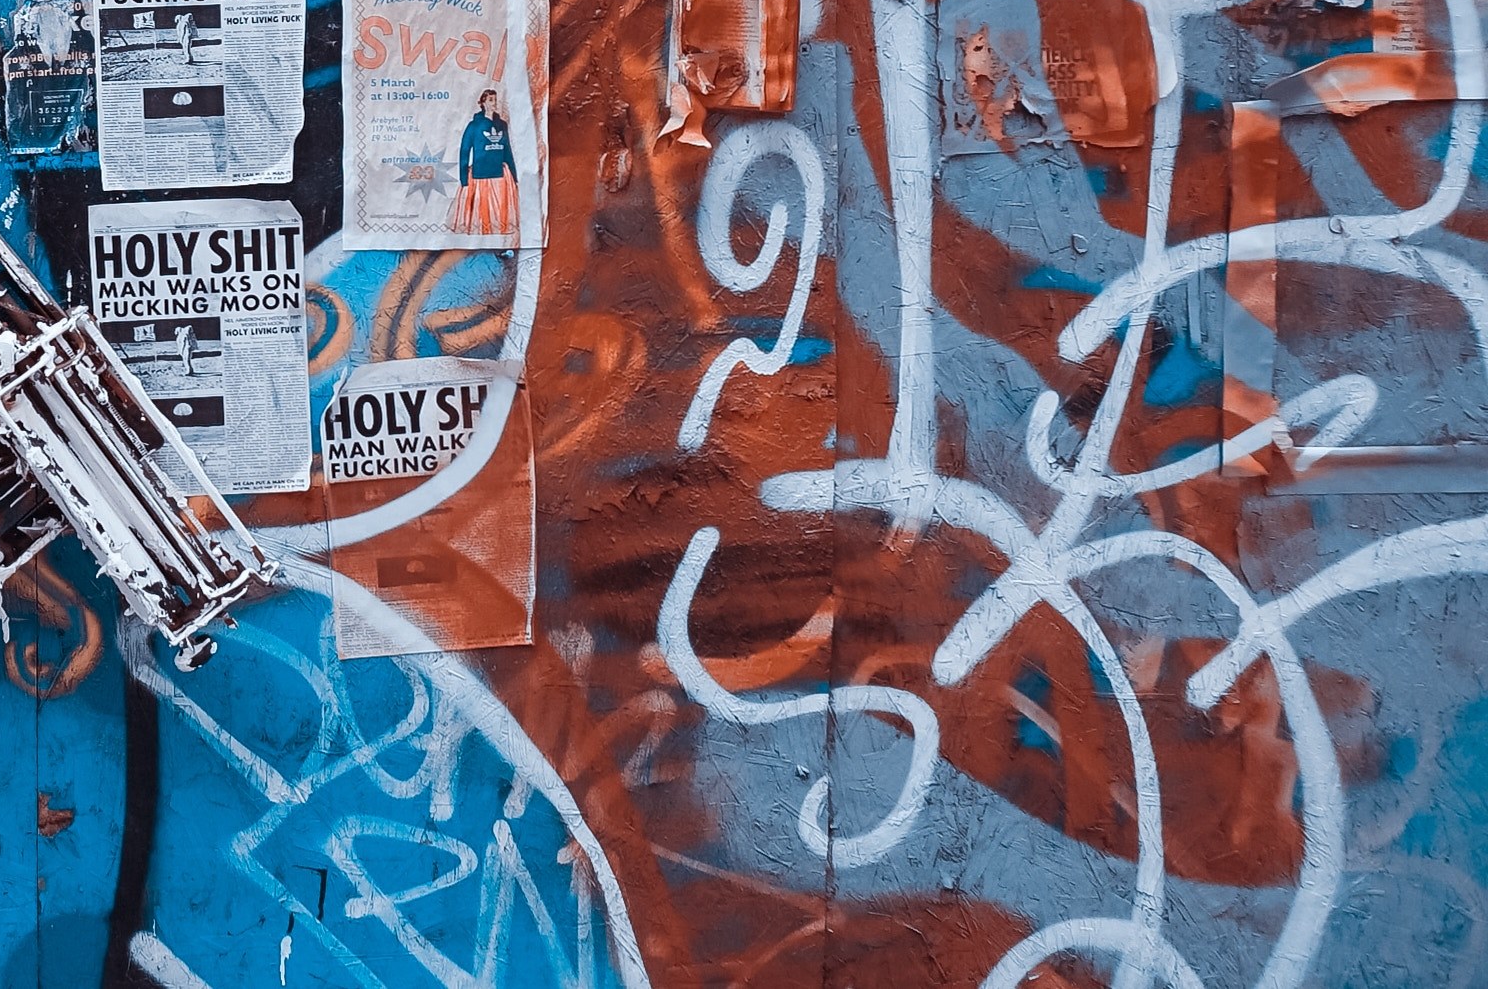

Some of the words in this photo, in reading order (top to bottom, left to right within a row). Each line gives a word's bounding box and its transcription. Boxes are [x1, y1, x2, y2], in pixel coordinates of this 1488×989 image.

[251, 15, 279, 24] LIVING
[353, 15, 508, 83] Swa
[370, 79, 377, 87] 5
[381, 78, 415, 87] March
[370, 92, 382, 101] at
[372, 125, 383, 133] 117
[381, 155, 421, 164] entrance
[94, 231, 200, 279] HOLY
[209, 227, 300, 274] SHIT
[99, 280, 155, 299] MAN
[167, 275, 251, 295] WALKS
[262, 273, 300, 291] ON
[101, 297, 209, 319] FUCKING
[220, 293, 299, 313] MOON
[251, 327, 278, 336] LIVING
[324, 388, 427, 441] HOLY
[329, 439, 384, 461] MAN
[331, 454, 438, 479] FUCKING
